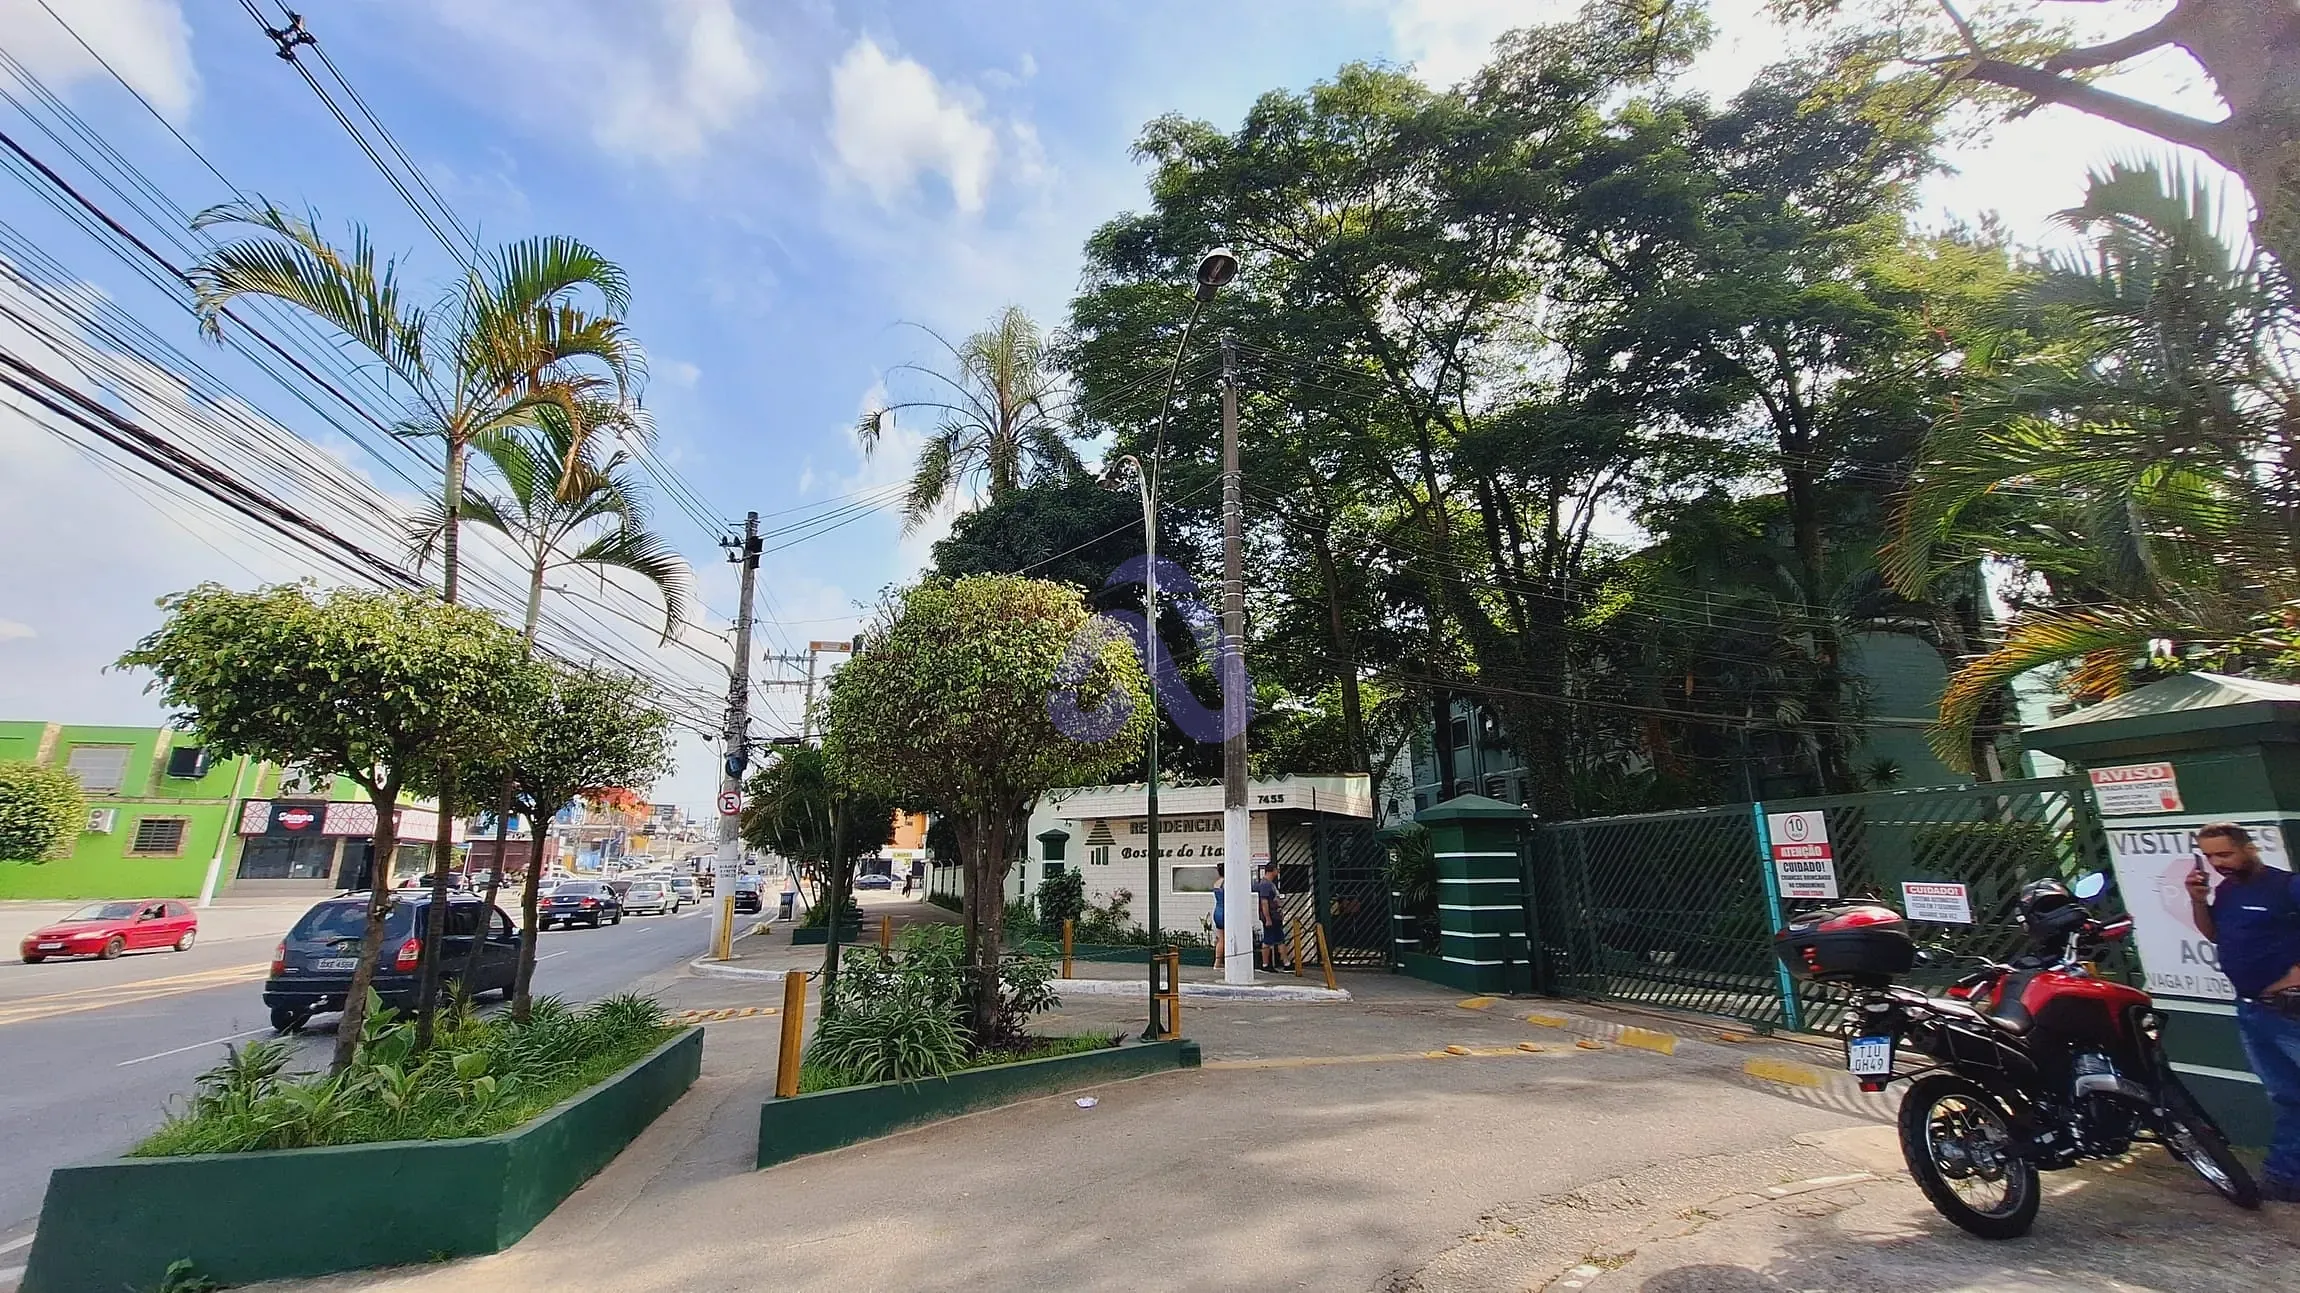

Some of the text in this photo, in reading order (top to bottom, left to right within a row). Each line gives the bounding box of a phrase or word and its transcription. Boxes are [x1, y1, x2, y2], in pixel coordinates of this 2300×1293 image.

[2098, 767, 2164, 782] AVISO
[1257, 794, 1285, 805] 7455
[1129, 819, 1225, 834] REIDENCIA
[1788, 818, 1803, 832] 10
[1121, 843, 1225, 859] Bosue do Ita
[1781, 844, 1823, 858] ATENÇÃO
[1783, 861, 1826, 873] CUIDADO!
[1910, 886, 1960, 896] CUIDADO!
[2203, 976, 2235, 994] IDE
[1860, 1045, 1881, 1058] TIU
